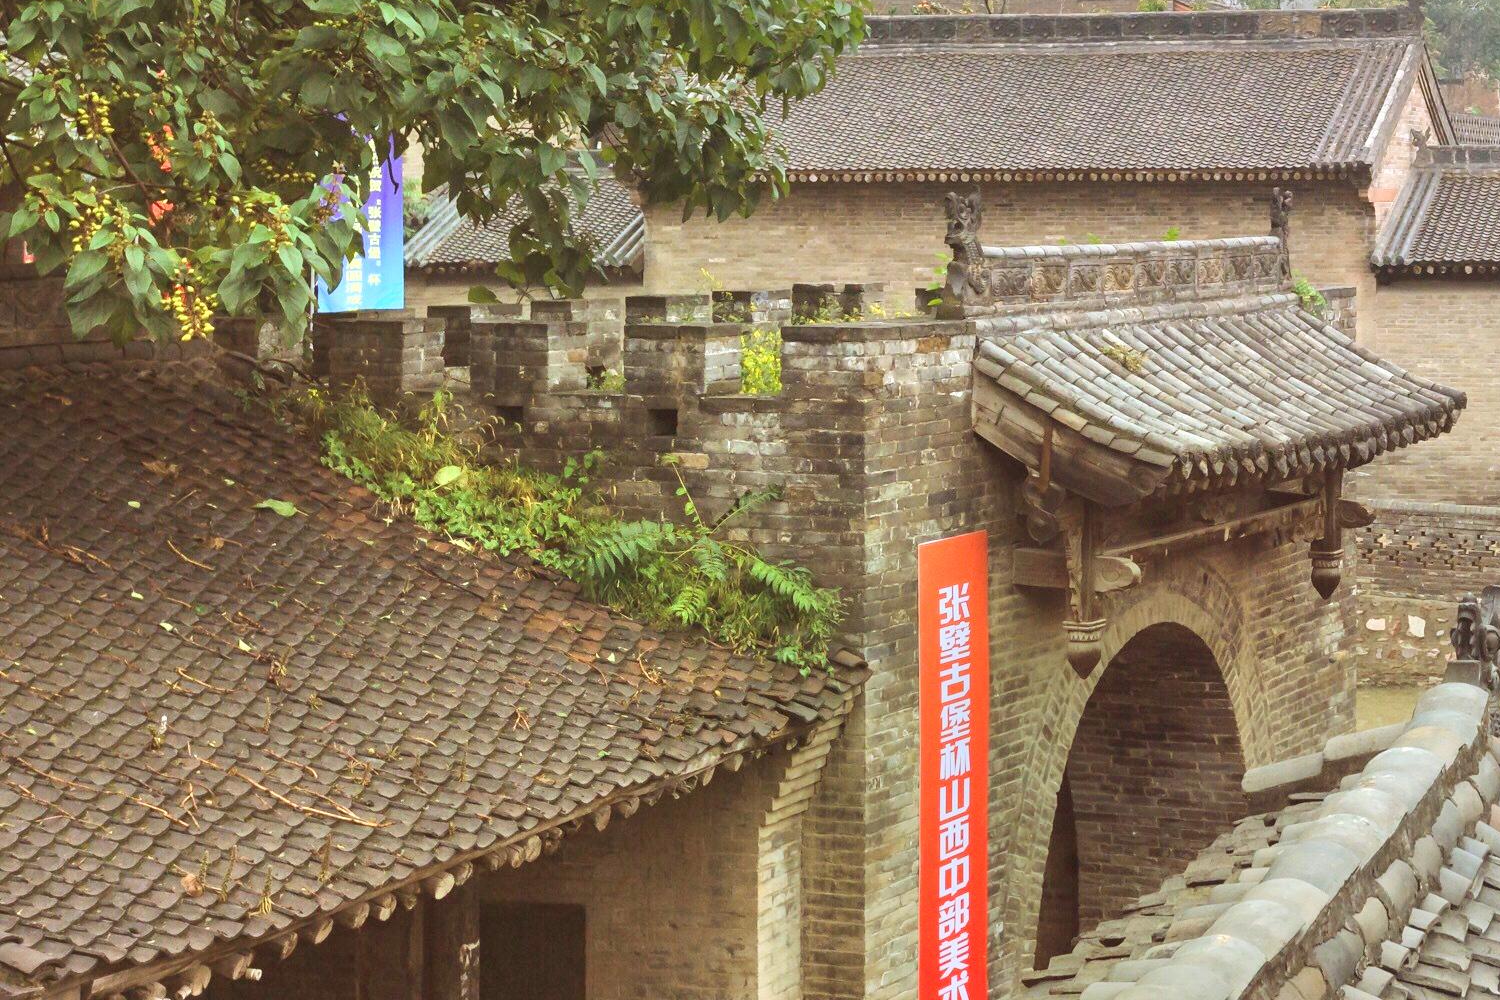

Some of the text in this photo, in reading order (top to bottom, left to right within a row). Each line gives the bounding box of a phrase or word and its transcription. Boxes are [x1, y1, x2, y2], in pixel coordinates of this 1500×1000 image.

[938, 582, 972, 1000] 张壁古堡杯山西中部美术
